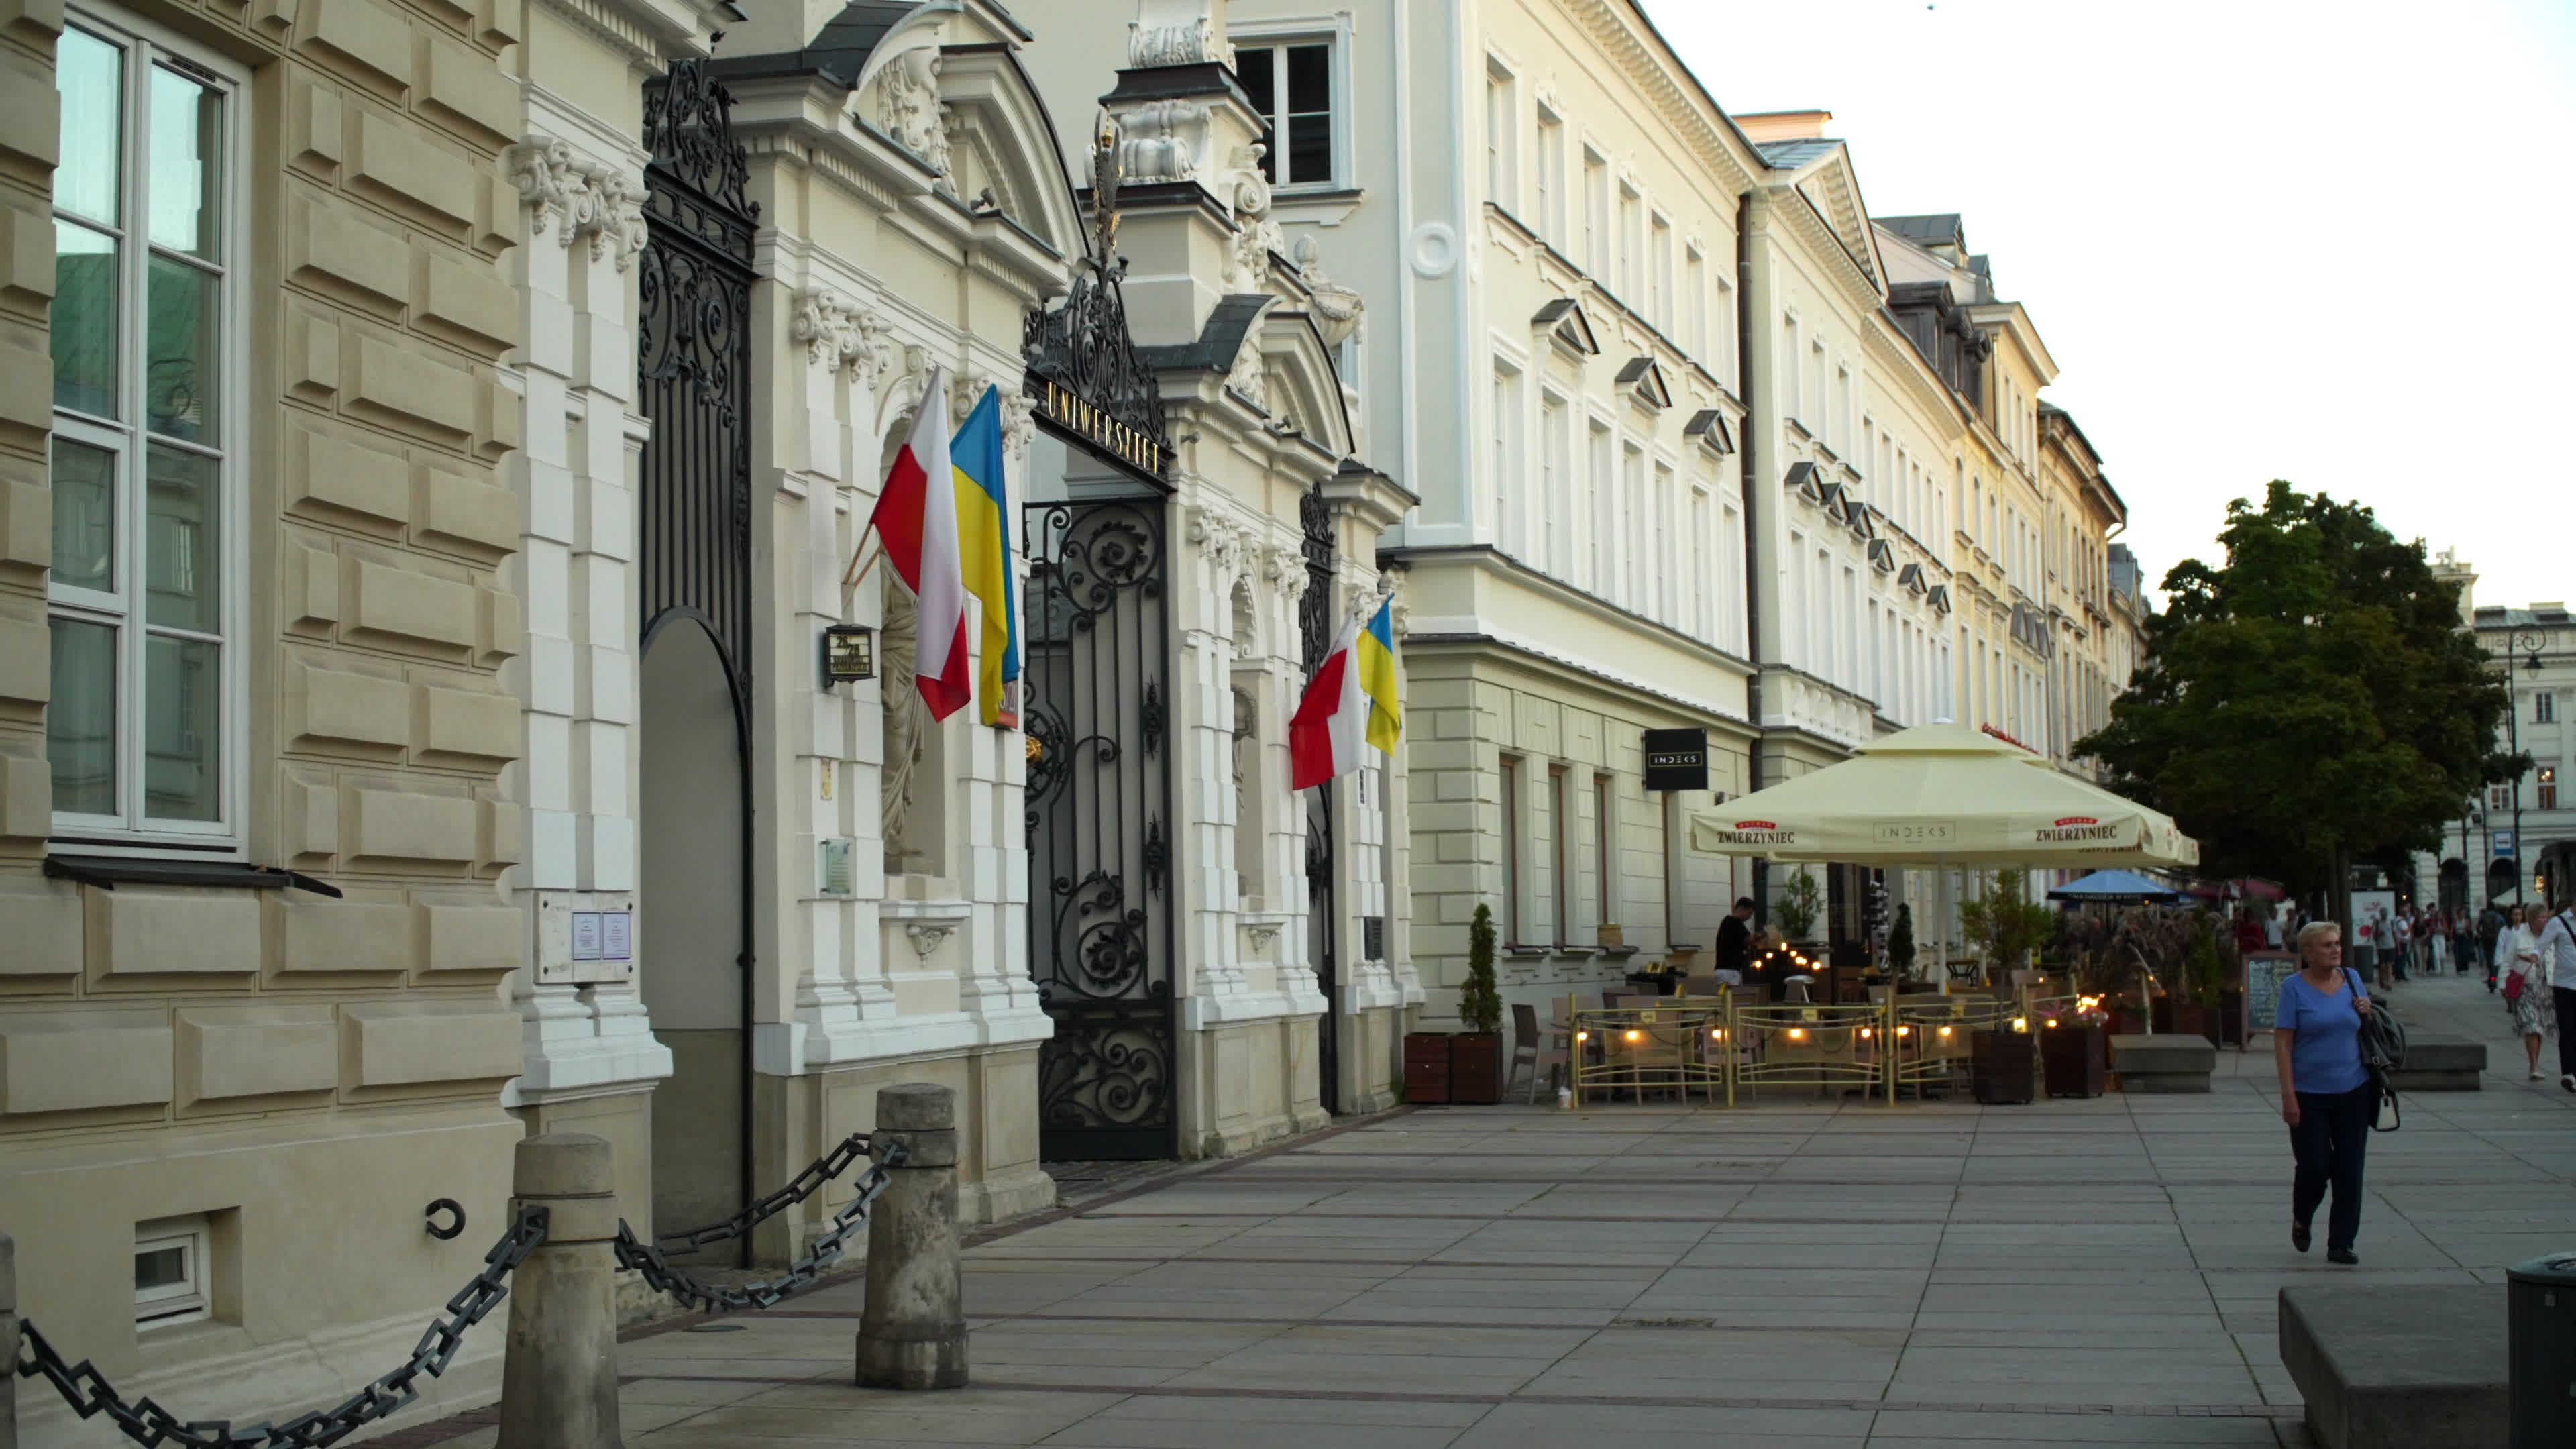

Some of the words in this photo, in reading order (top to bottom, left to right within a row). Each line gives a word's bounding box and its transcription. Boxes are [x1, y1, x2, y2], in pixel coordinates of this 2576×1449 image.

[1047, 381, 1159, 474] UNIWERSYTET
[1654, 755, 1697, 765] INDEKS
[1717, 831, 1795, 844] ZWIERZYNIEC
[1882, 826, 1947, 838] INDEKS
[2035, 826, 2117, 842] ZWIERZYNIEC
